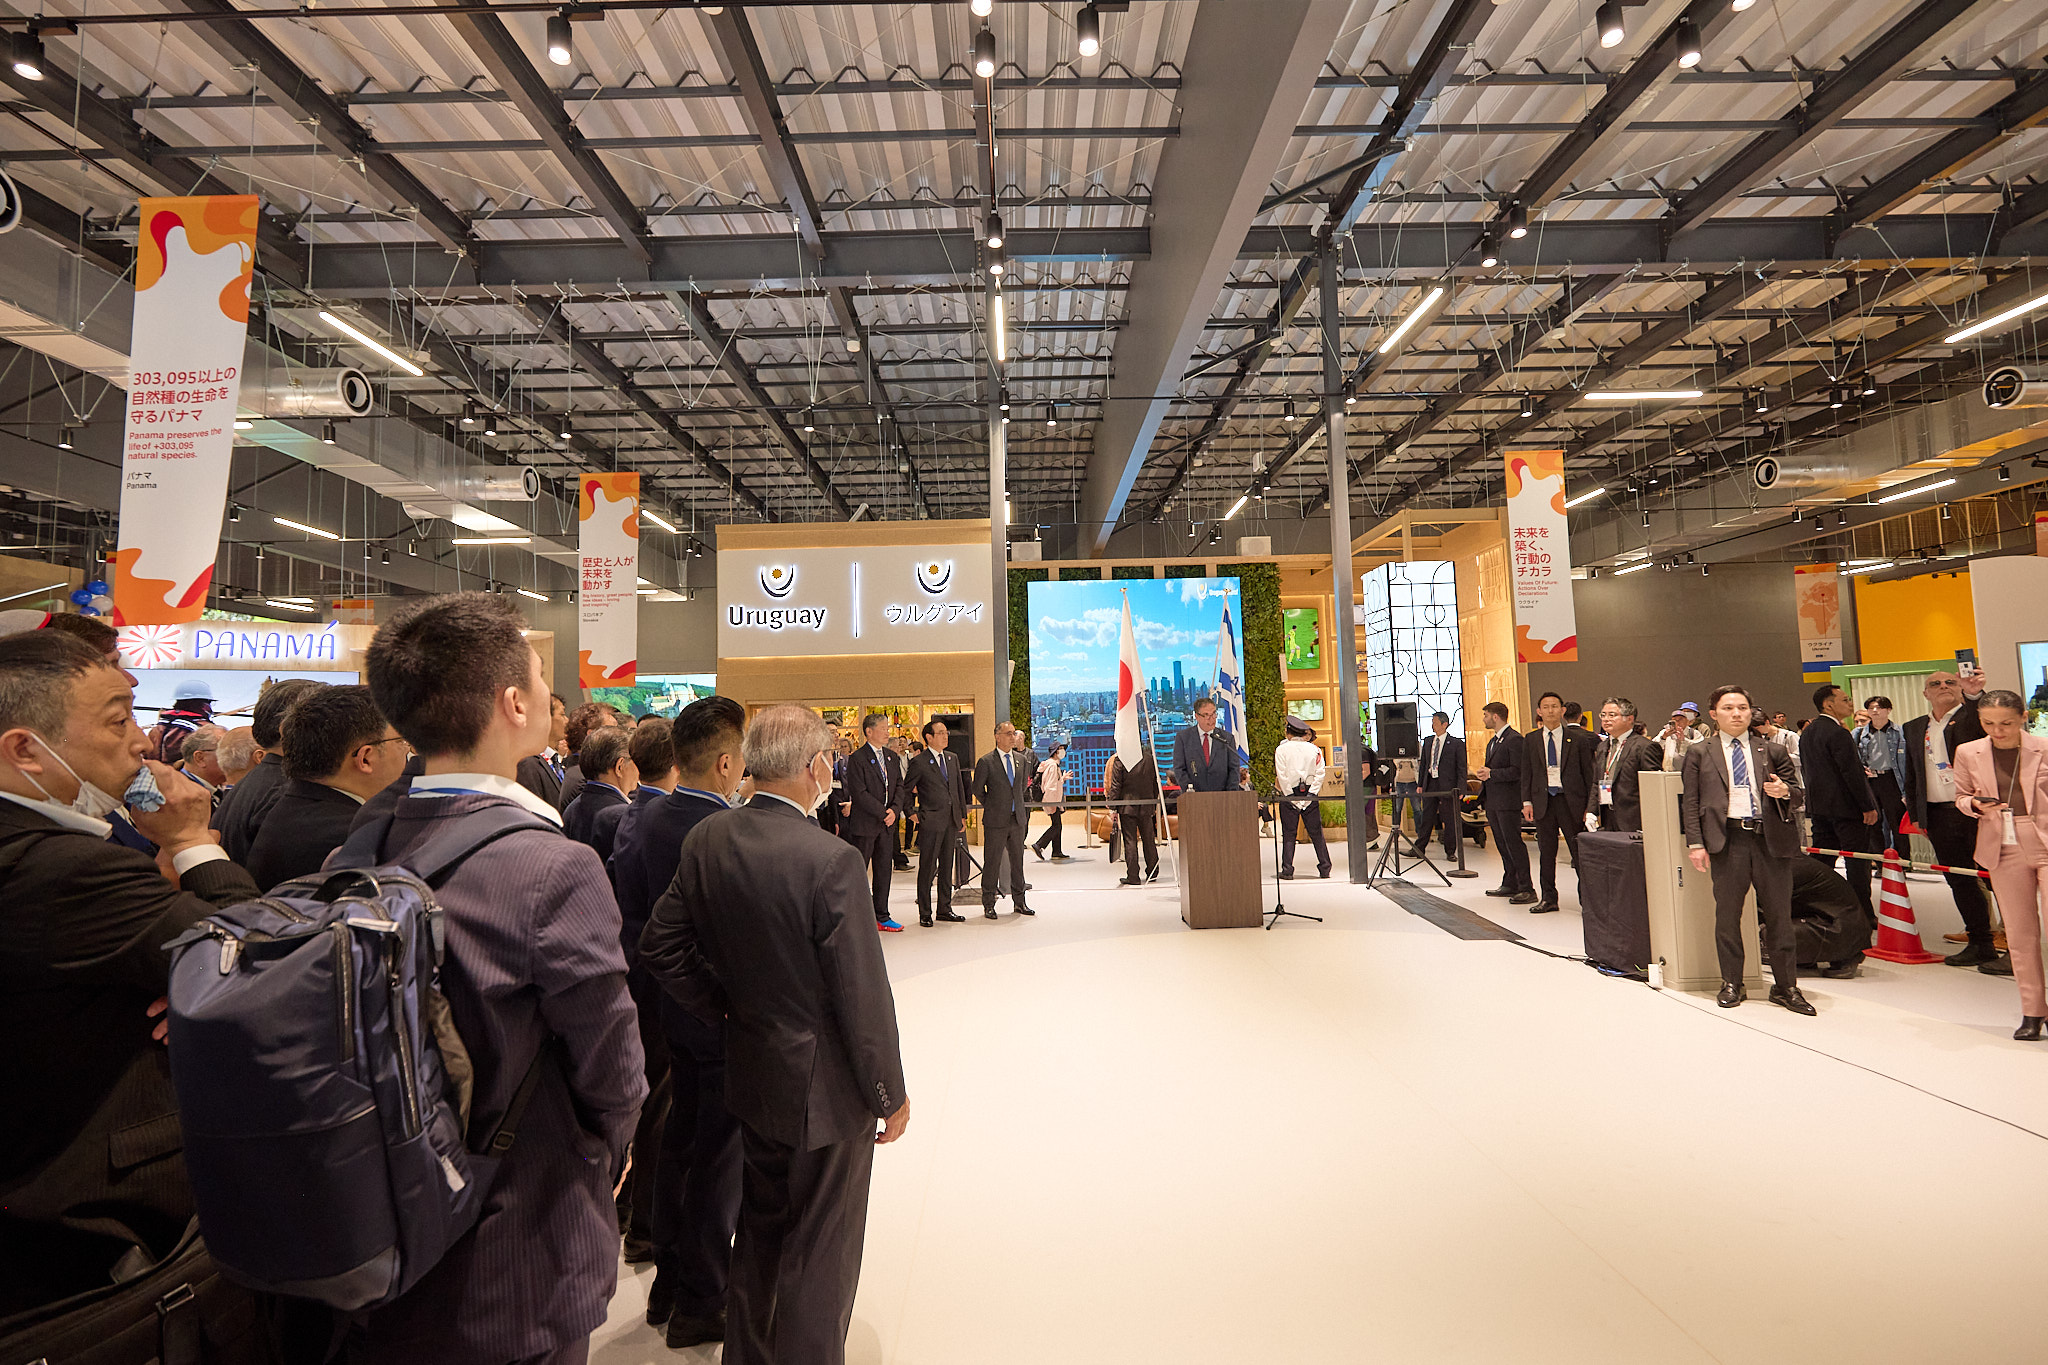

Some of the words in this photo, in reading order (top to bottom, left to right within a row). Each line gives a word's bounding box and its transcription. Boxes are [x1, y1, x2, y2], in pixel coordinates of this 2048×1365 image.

[133, 367, 237, 387] 303,095以上の
[132, 387, 229, 405] 自然種の生命を
[130, 409, 203, 424] 守るパナマ
[129, 432, 164, 440] Panama
[167, 430, 209, 440] preserves
[128, 443, 141, 451] life
[142, 442, 151, 450] of
[153, 441, 194, 451] +303,095
[128, 452, 158, 460] natural
[161, 451, 198, 460] species.
[127, 472, 152, 480] パナマ
[1514, 527, 1549, 538] 未来を
[1514, 540, 1544, 552] 築く、
[582, 556, 635, 568] 歴史と人が
[1515, 553, 1551, 565] 行動の
[582, 569, 613, 579] 未来を
[1517, 566, 1552, 577] チカラ
[582, 580, 613, 590] 動かす
[729, 606, 826, 629] Uruguay
[886, 603, 983, 624] ウルグアイ
[194, 619, 339, 660] PANAMÁ
